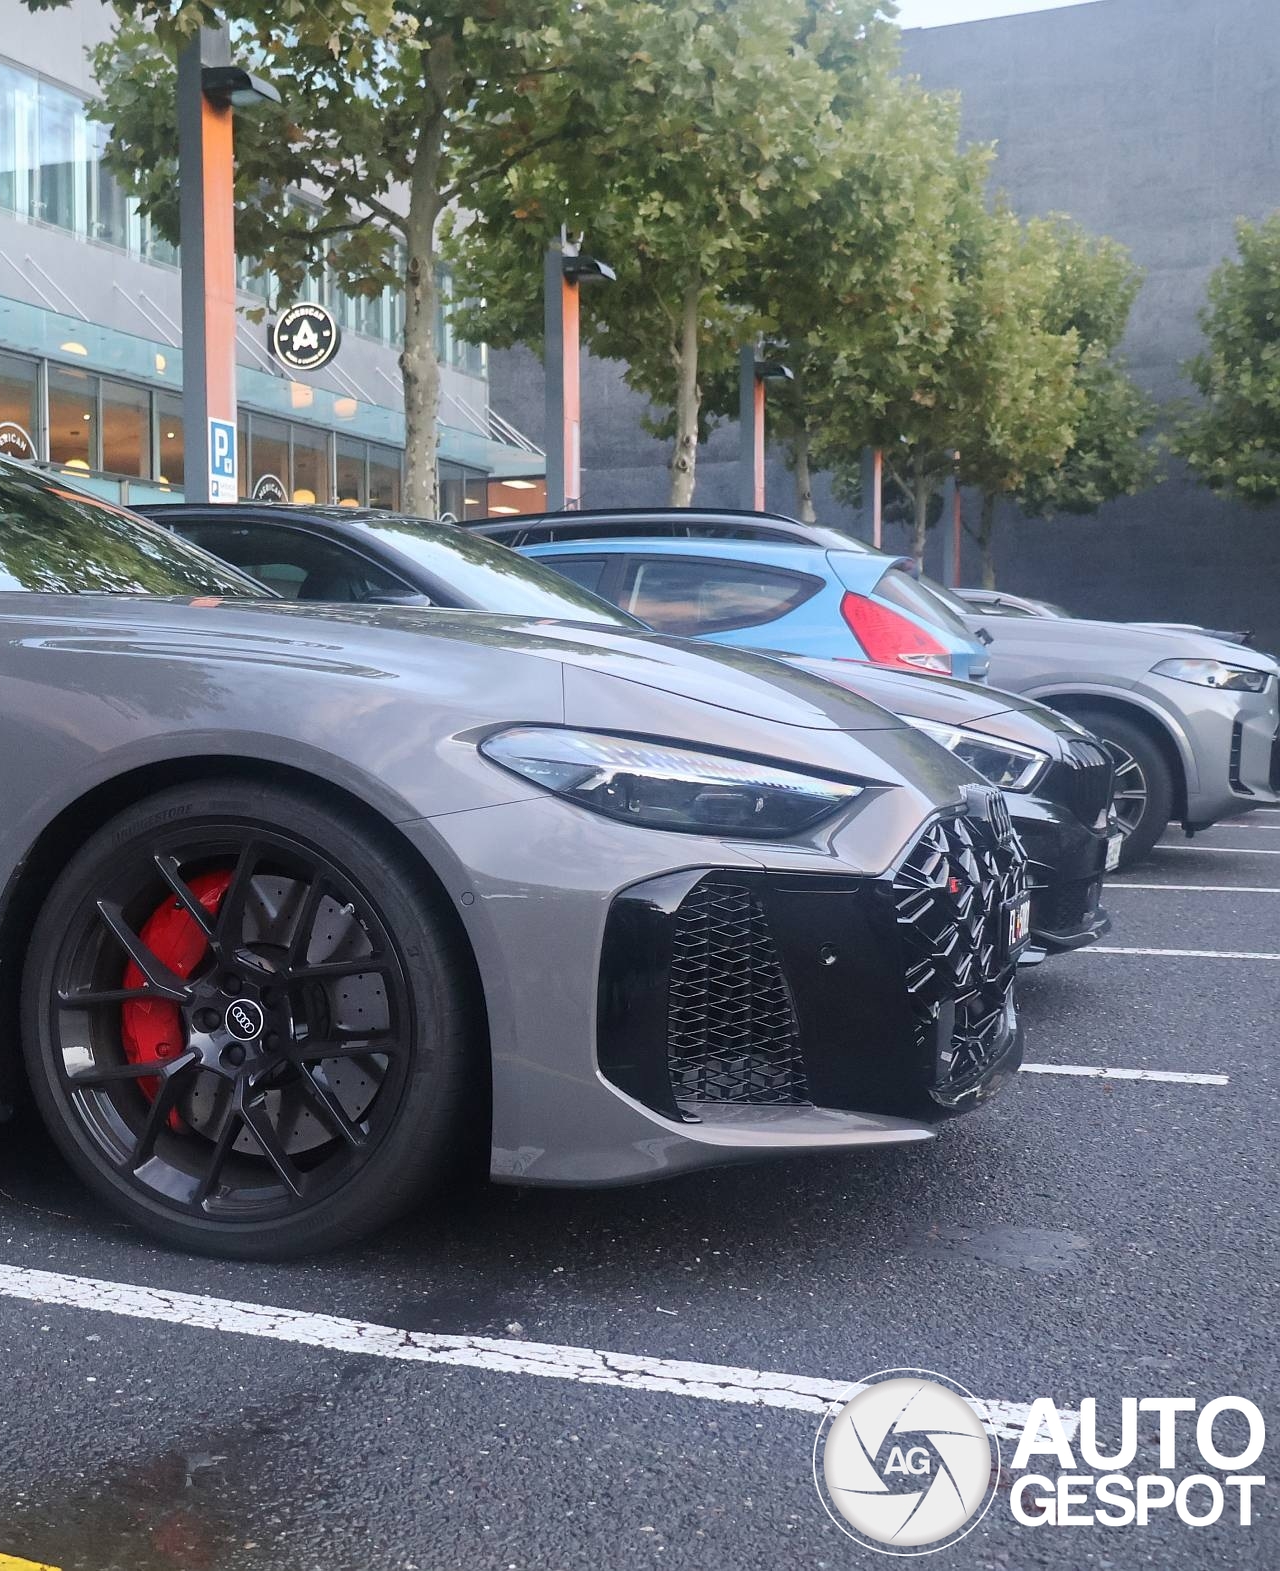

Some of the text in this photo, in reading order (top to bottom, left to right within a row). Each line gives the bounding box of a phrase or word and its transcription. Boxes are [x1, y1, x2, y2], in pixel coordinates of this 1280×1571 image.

[284, 308, 326, 326] AMERICAN
[214, 428, 229, 468] P
[258, 483, 282, 500] MERICAN
